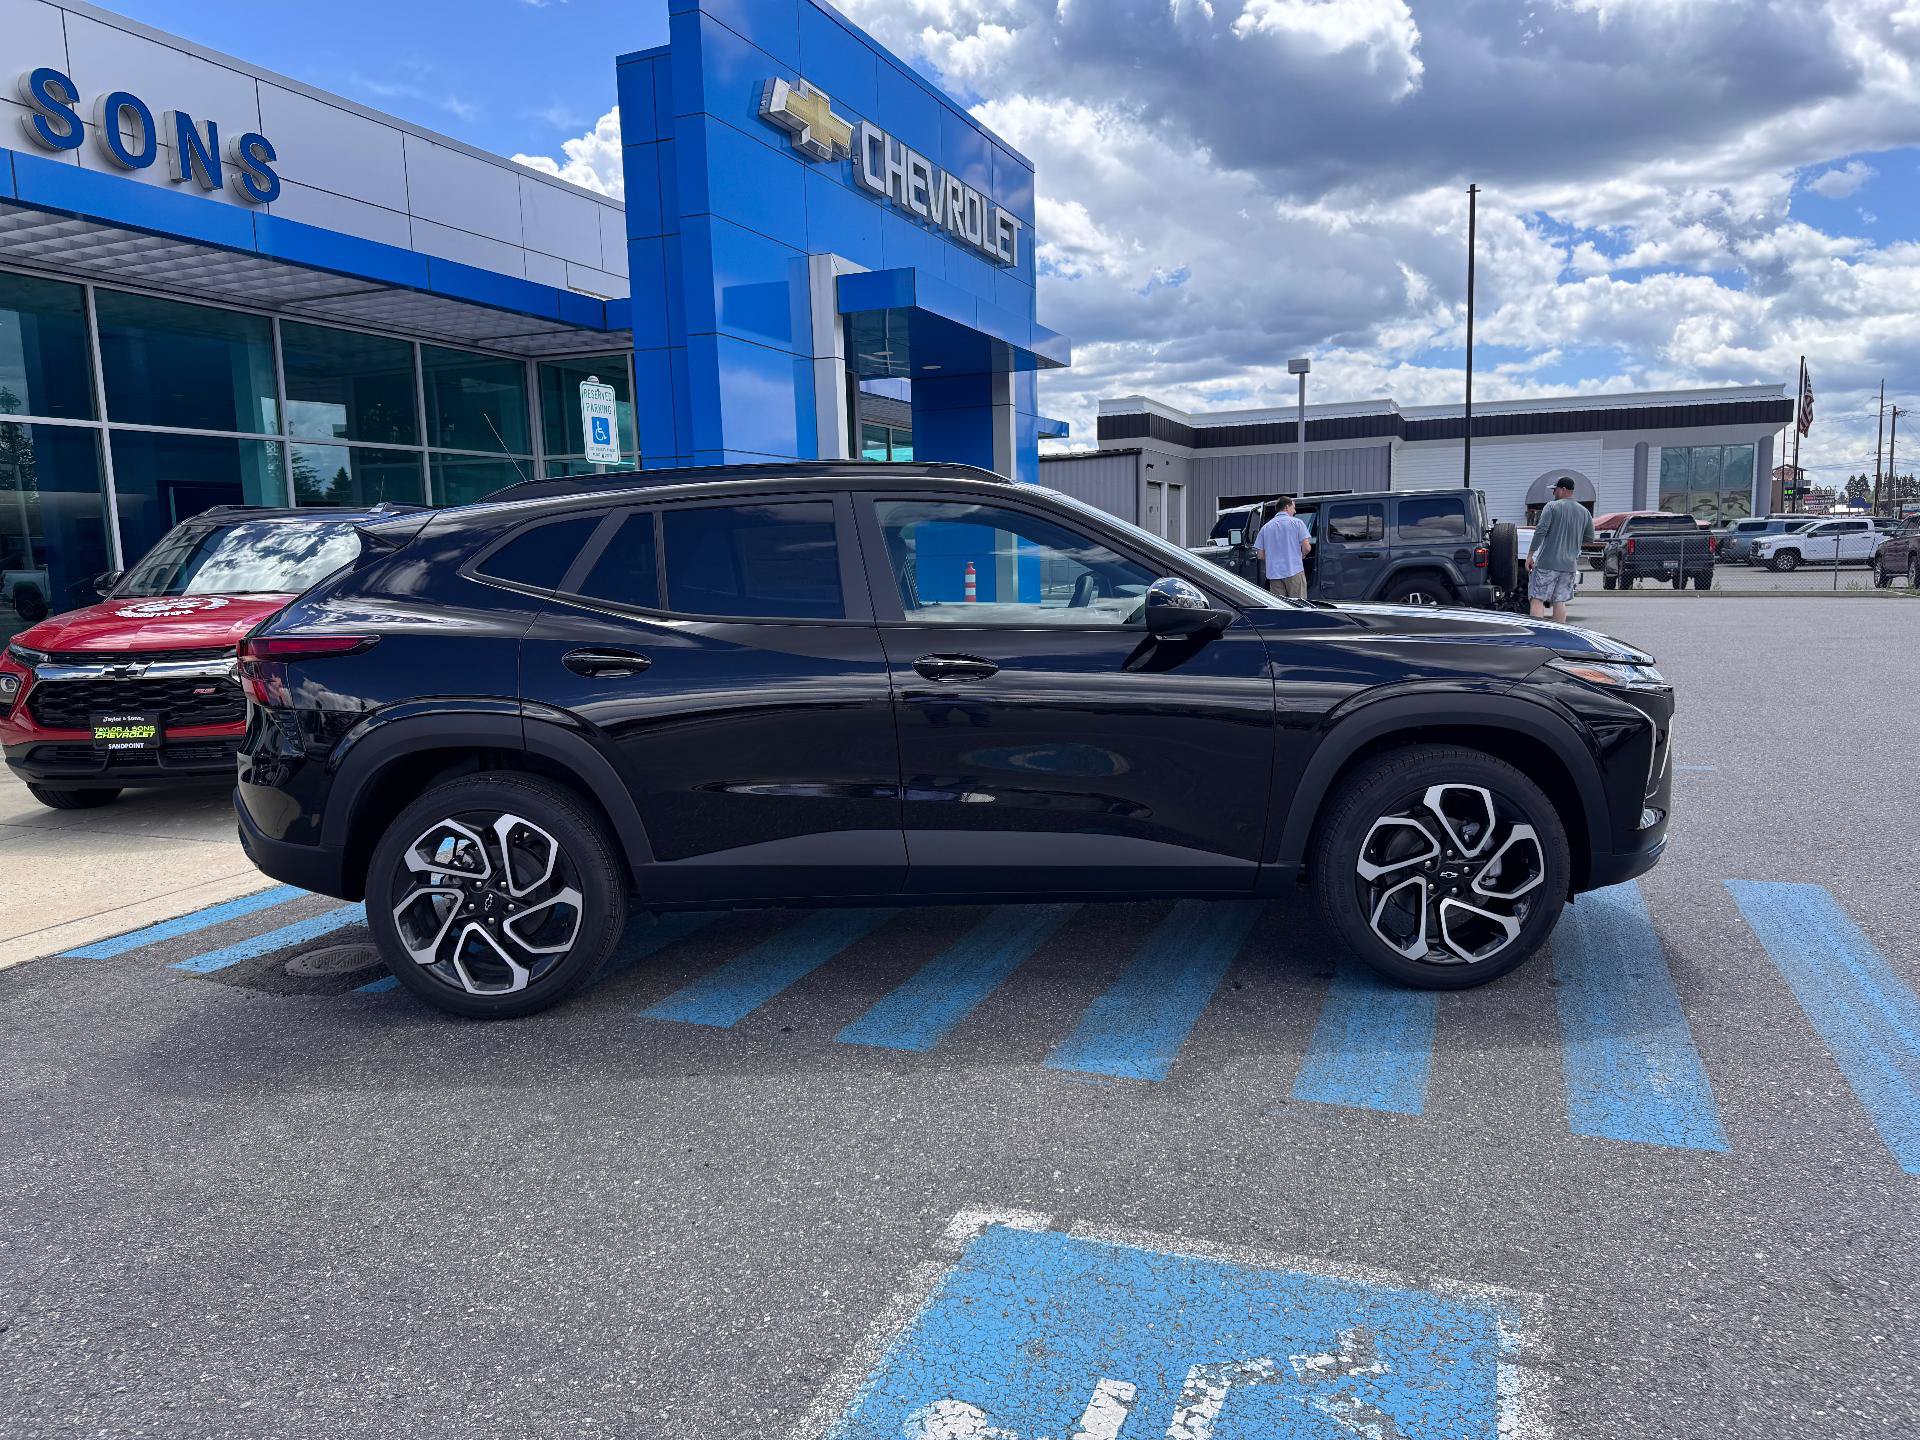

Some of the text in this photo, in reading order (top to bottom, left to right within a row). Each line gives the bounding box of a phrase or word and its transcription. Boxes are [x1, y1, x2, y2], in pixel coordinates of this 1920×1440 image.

[19, 67, 281, 203] SONS
[853, 120, 1022, 268] CHEVROLET
[583, 388, 613, 402] RESERVED
[586, 402, 612, 415] PARKING
[94, 726, 123, 734] TAYLOR
[132, 725, 156, 733] SONS
[95, 731, 156, 739] CHEVROLET
[108, 742, 145, 750] SANDPOINT
